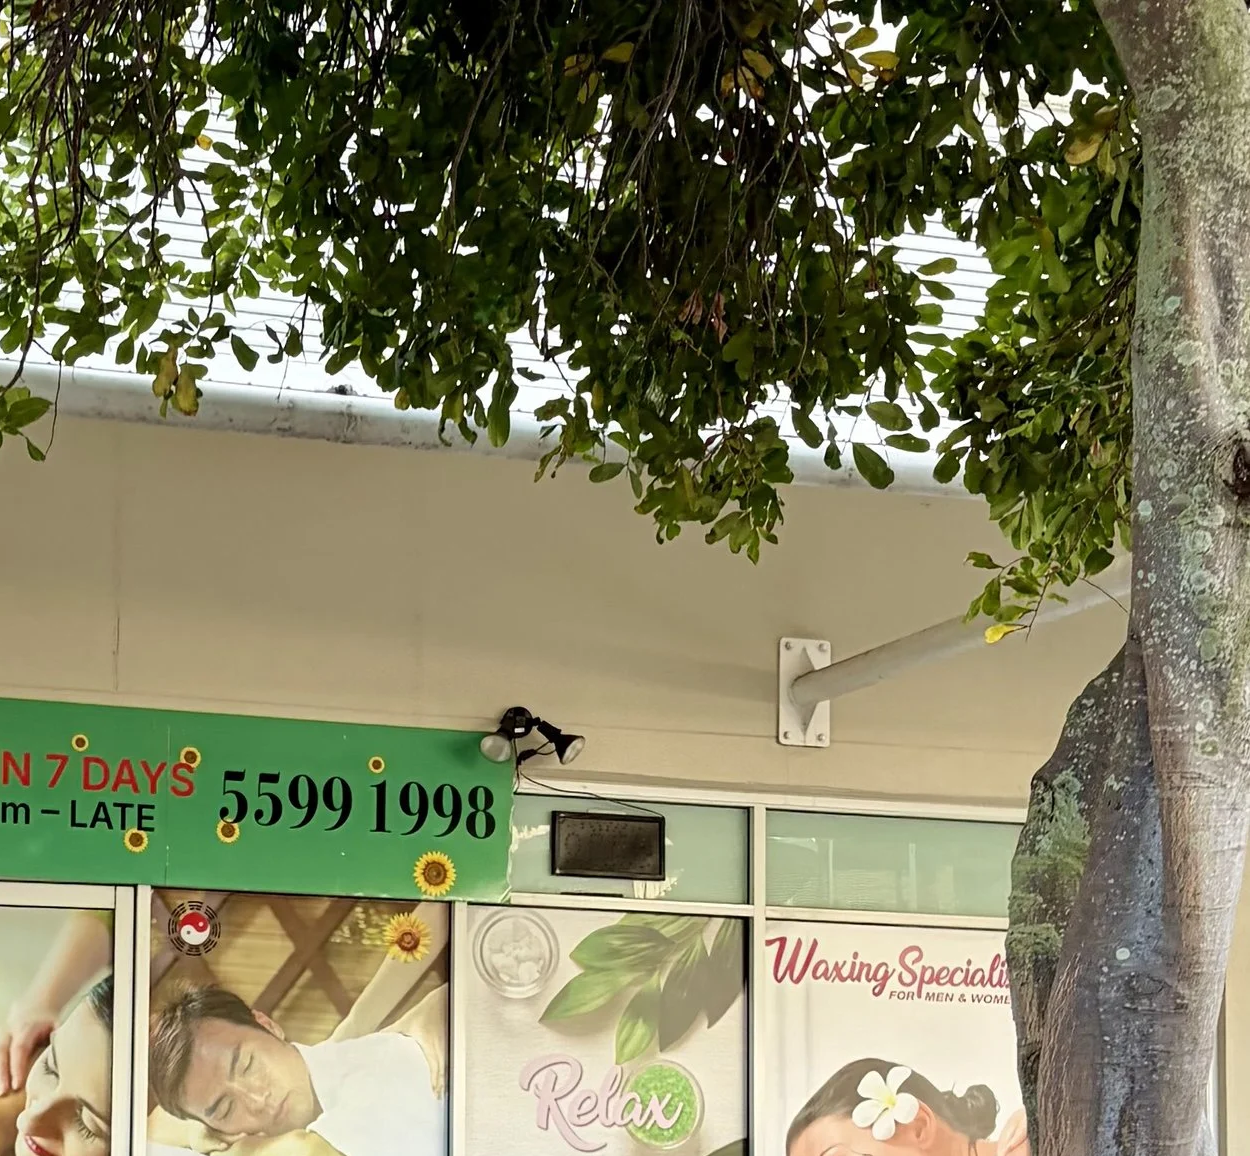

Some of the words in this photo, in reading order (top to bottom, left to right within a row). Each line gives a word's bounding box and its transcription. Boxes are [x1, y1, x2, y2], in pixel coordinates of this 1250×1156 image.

[45, 753, 70, 788] 7
[81, 756, 196, 797] DAYS
[70, 800, 156, 832] LATE
[219, 769, 353, 831] 5599
[369, 779, 497, 840] 1998
[765, 936, 896, 997] Waxing
[898, 945, 1011, 999] Speciali
[889, 990, 915, 1002] FOR
[925, 992, 953, 1003] MEN
[958, 994, 967, 1004] &
[971, 993, 1011, 1005] WOME
[519, 1053, 683, 1153] Relax
